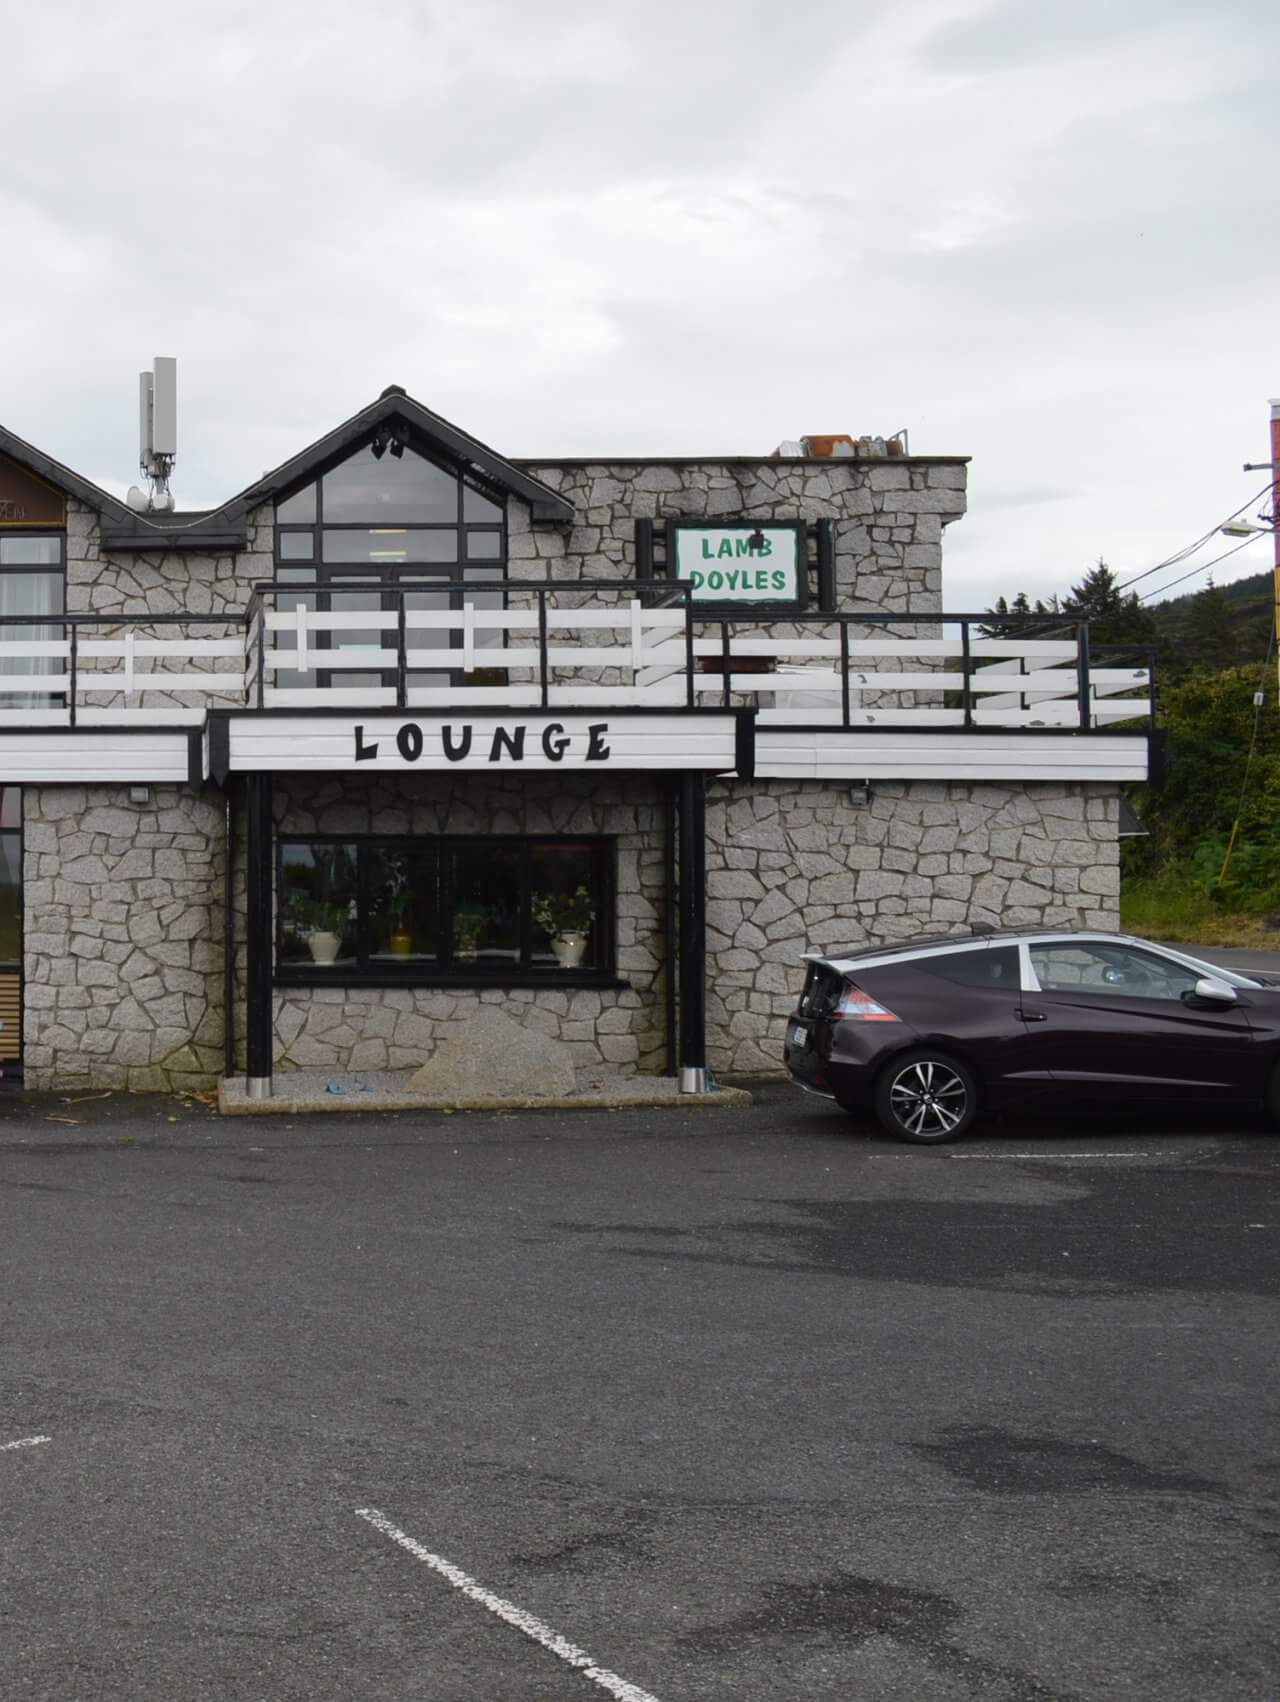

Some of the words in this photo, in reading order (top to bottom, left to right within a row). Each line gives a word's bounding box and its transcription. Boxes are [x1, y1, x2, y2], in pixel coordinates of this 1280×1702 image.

[701, 537, 773, 559] LAMB
[689, 569, 786, 591] DOYLES
[354, 723, 611, 762] LOUNGE
